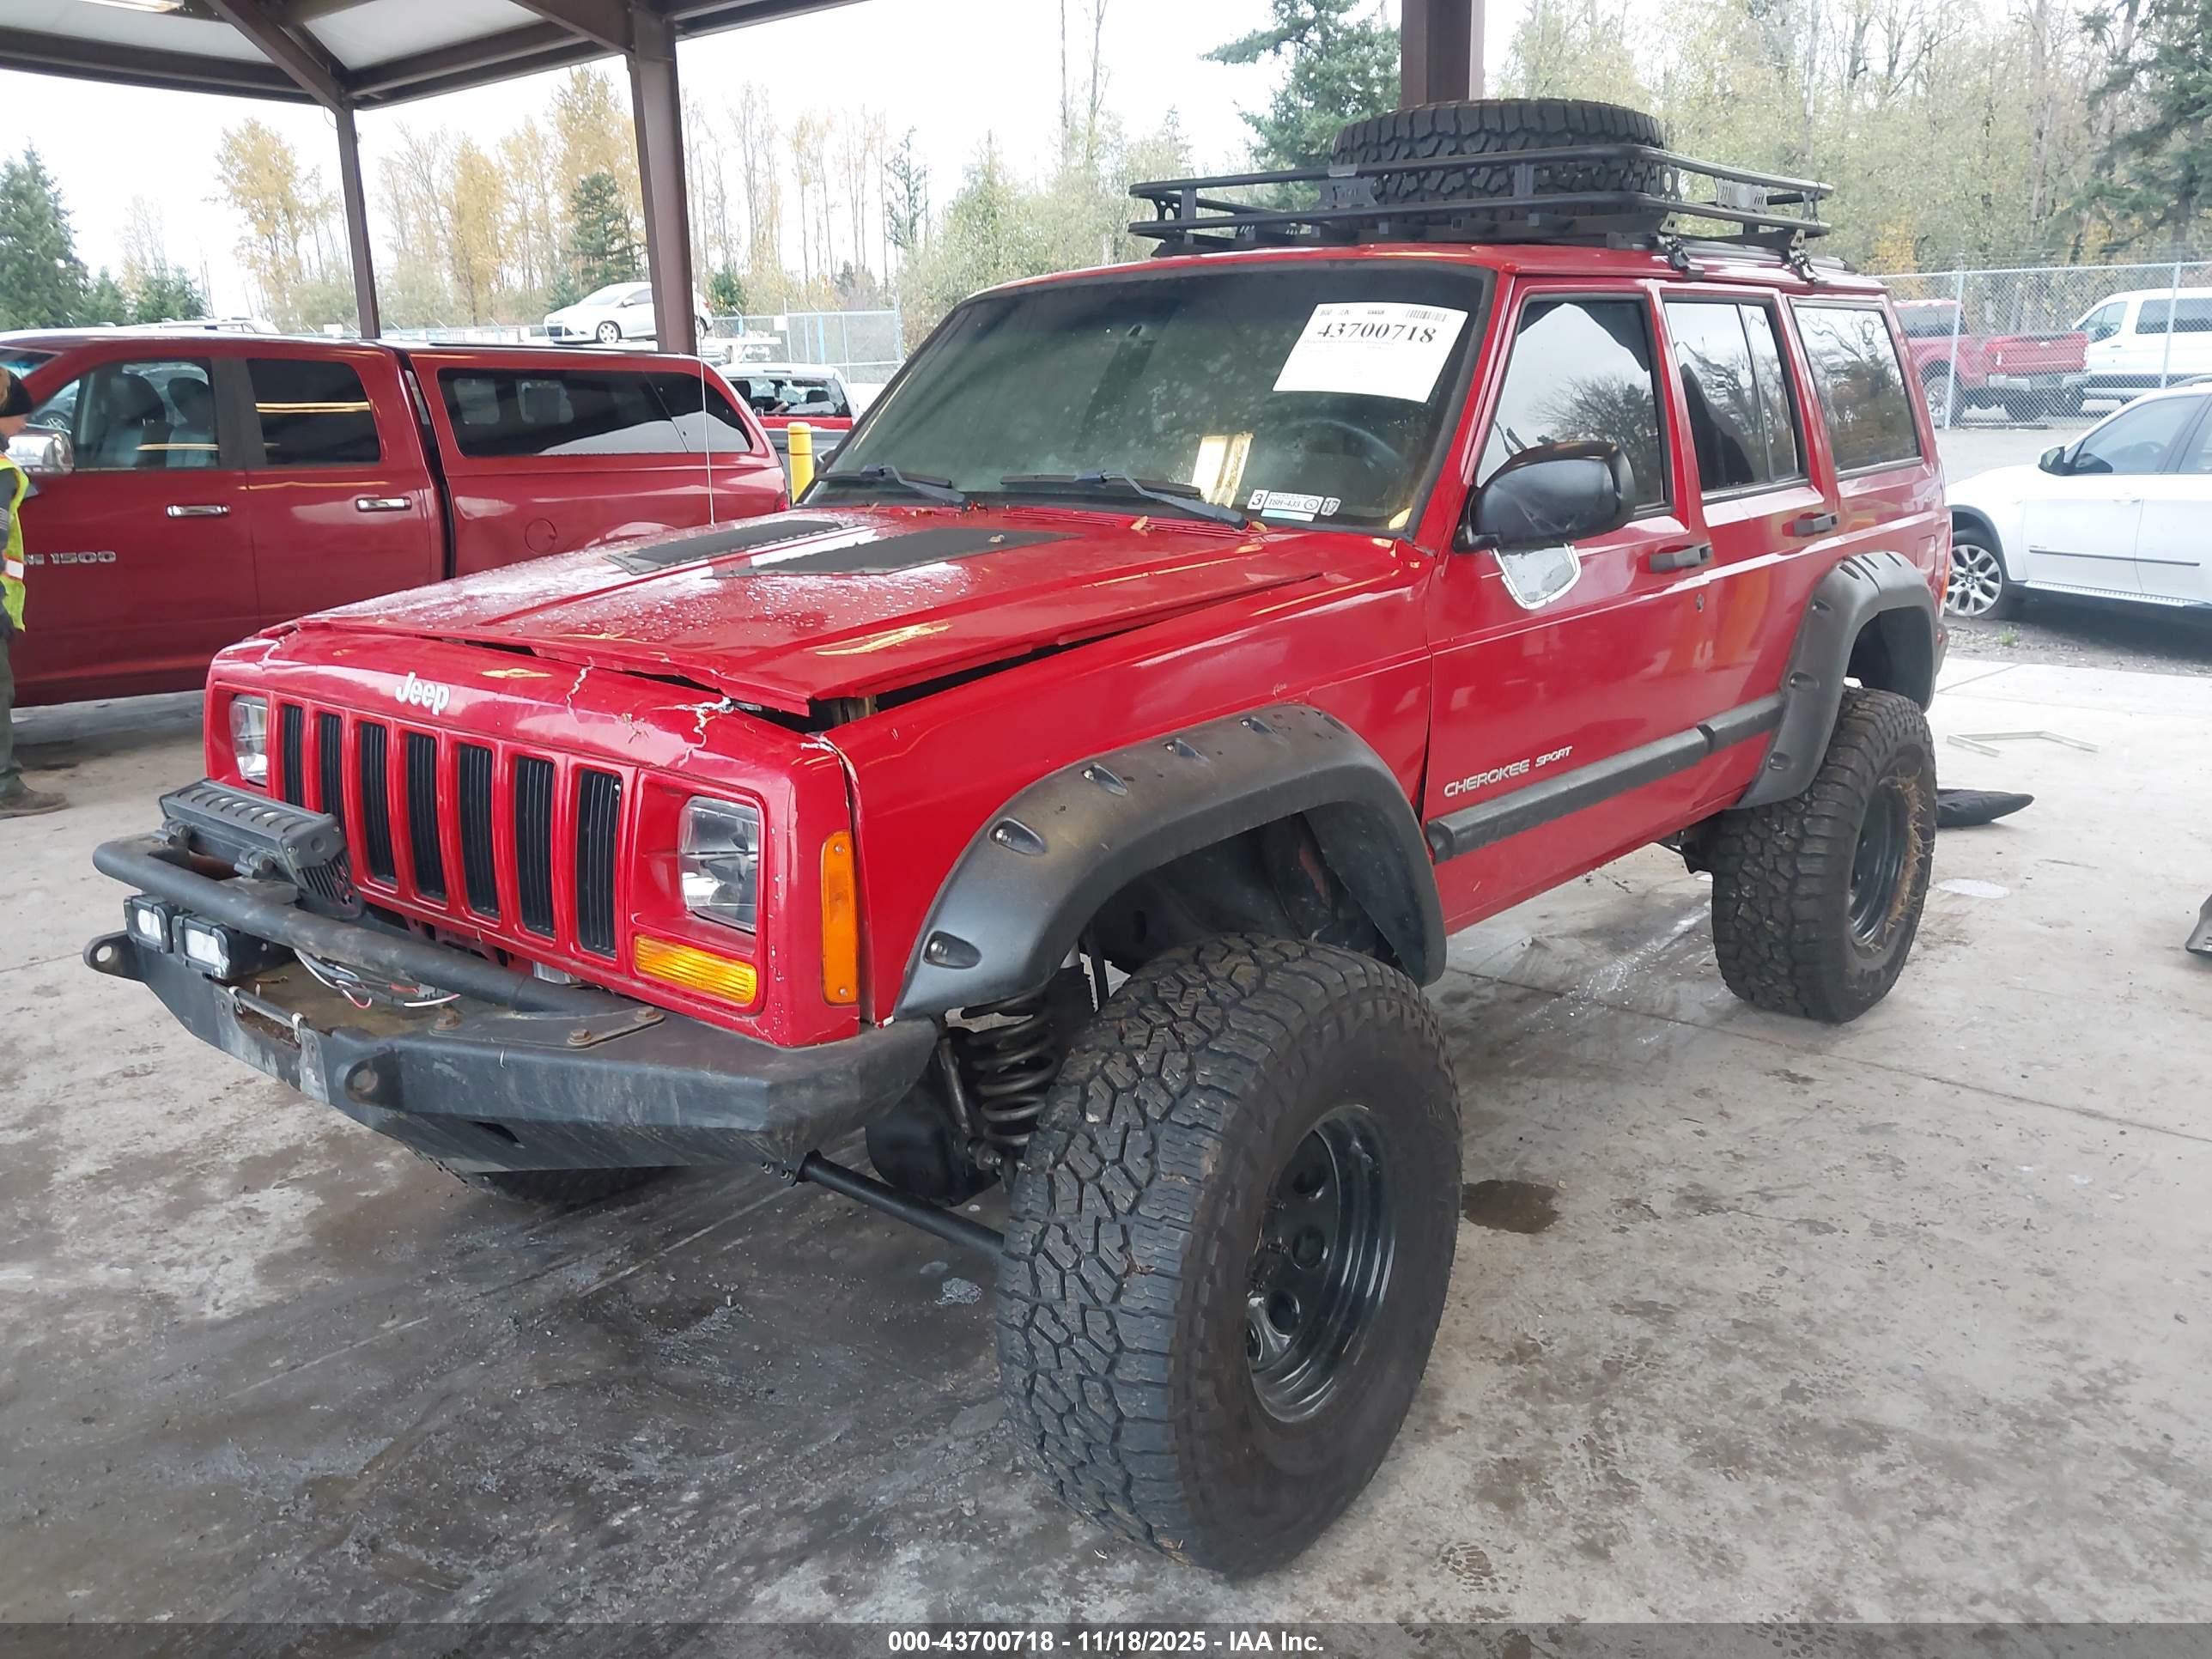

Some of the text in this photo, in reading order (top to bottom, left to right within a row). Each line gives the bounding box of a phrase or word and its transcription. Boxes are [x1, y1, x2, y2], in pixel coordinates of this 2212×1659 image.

[1317, 322, 1437, 343] 43700718
[1252, 494, 1263, 505] 3
[50, 550, 117, 564] 1500
[395, 671, 450, 715] Jeep
[1444, 745, 1573, 797] CHEROKEE SPORT
